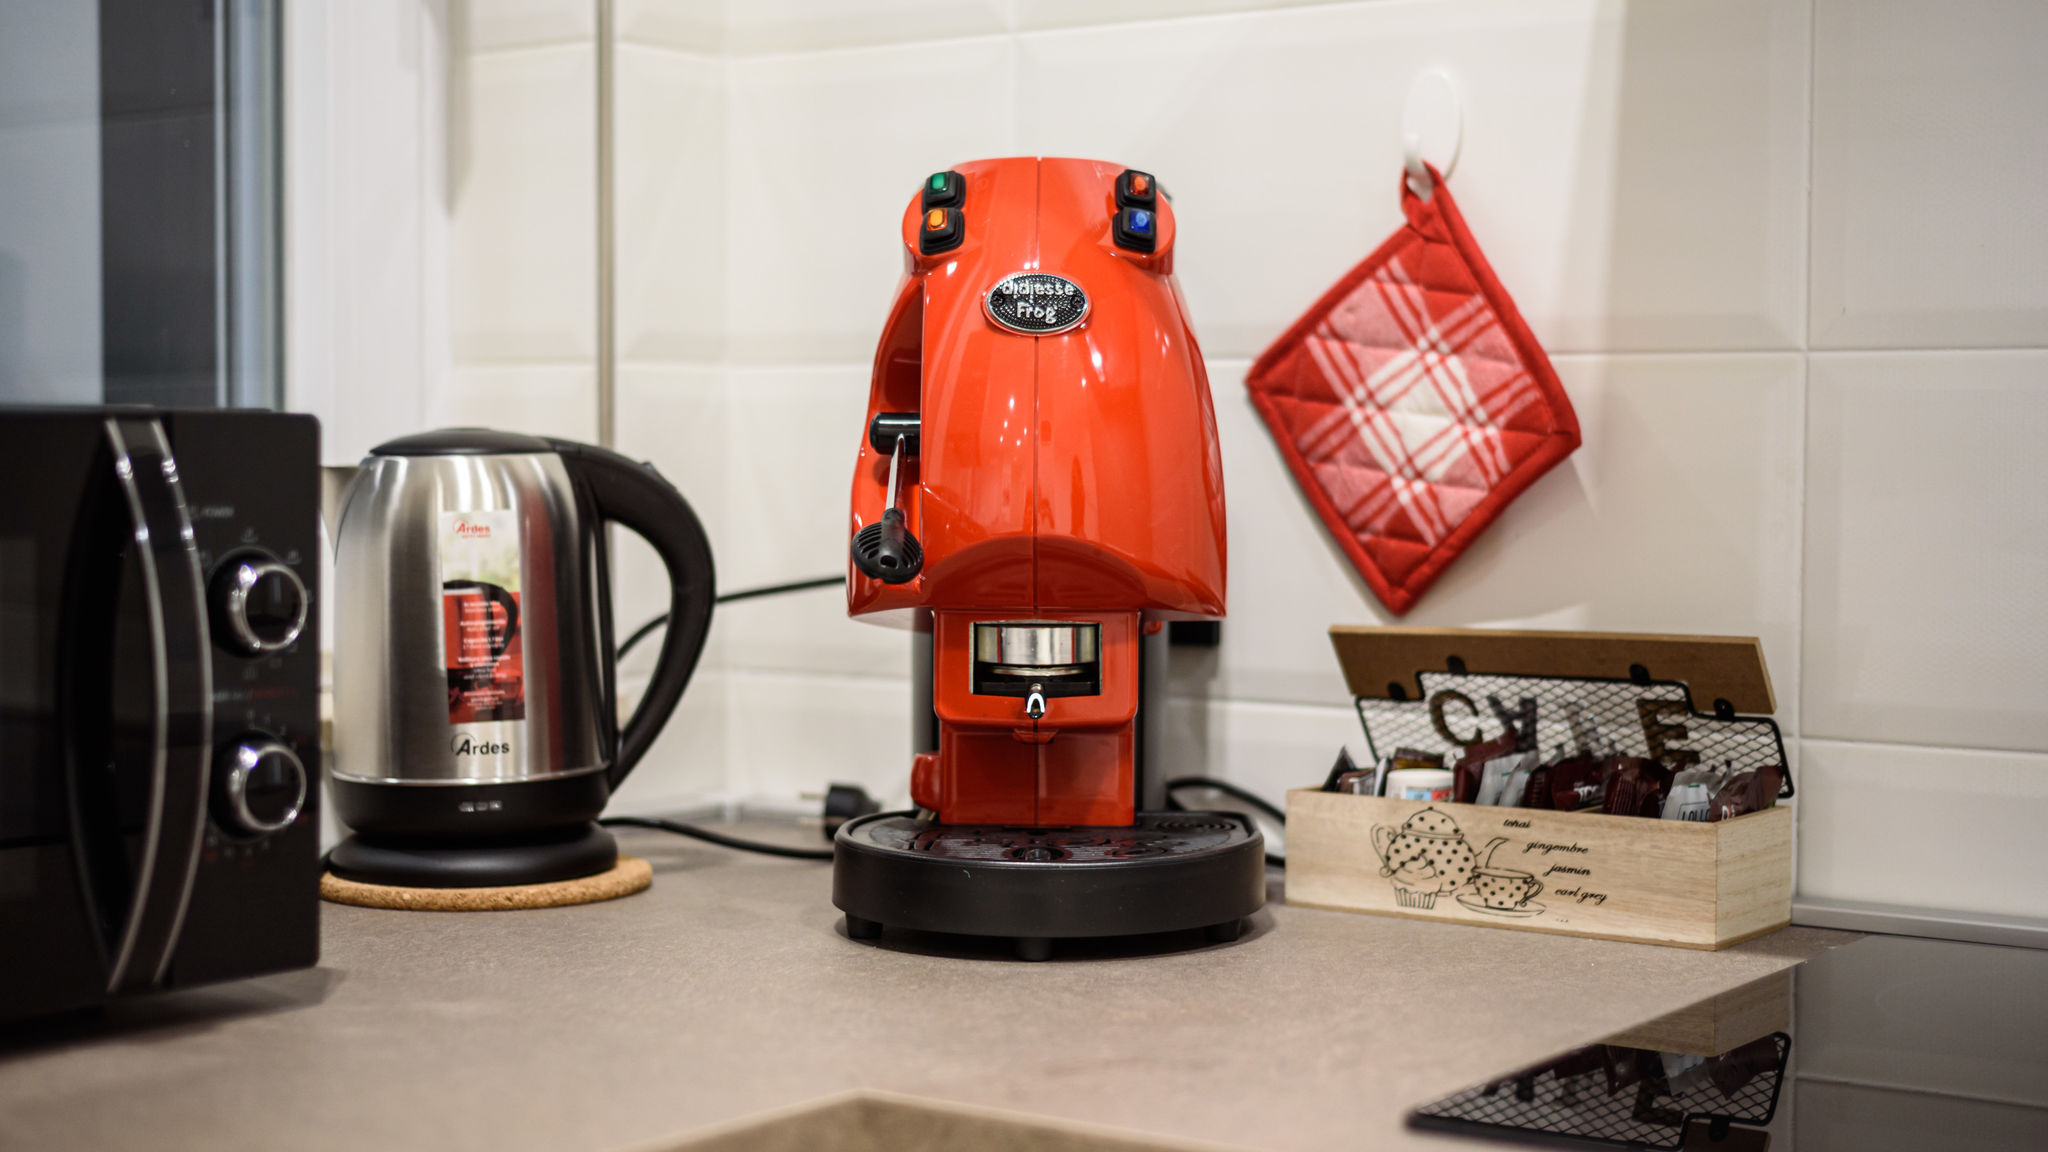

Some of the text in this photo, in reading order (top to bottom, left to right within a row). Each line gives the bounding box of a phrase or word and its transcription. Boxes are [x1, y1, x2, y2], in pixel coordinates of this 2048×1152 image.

[1001, 280, 1075, 296] didiesse
[1017, 301, 1057, 324] Frog
[455, 738, 510, 756] Ardes
[1542, 864, 1591, 877] jasmin
[1555, 886, 1607, 905] earl grey
